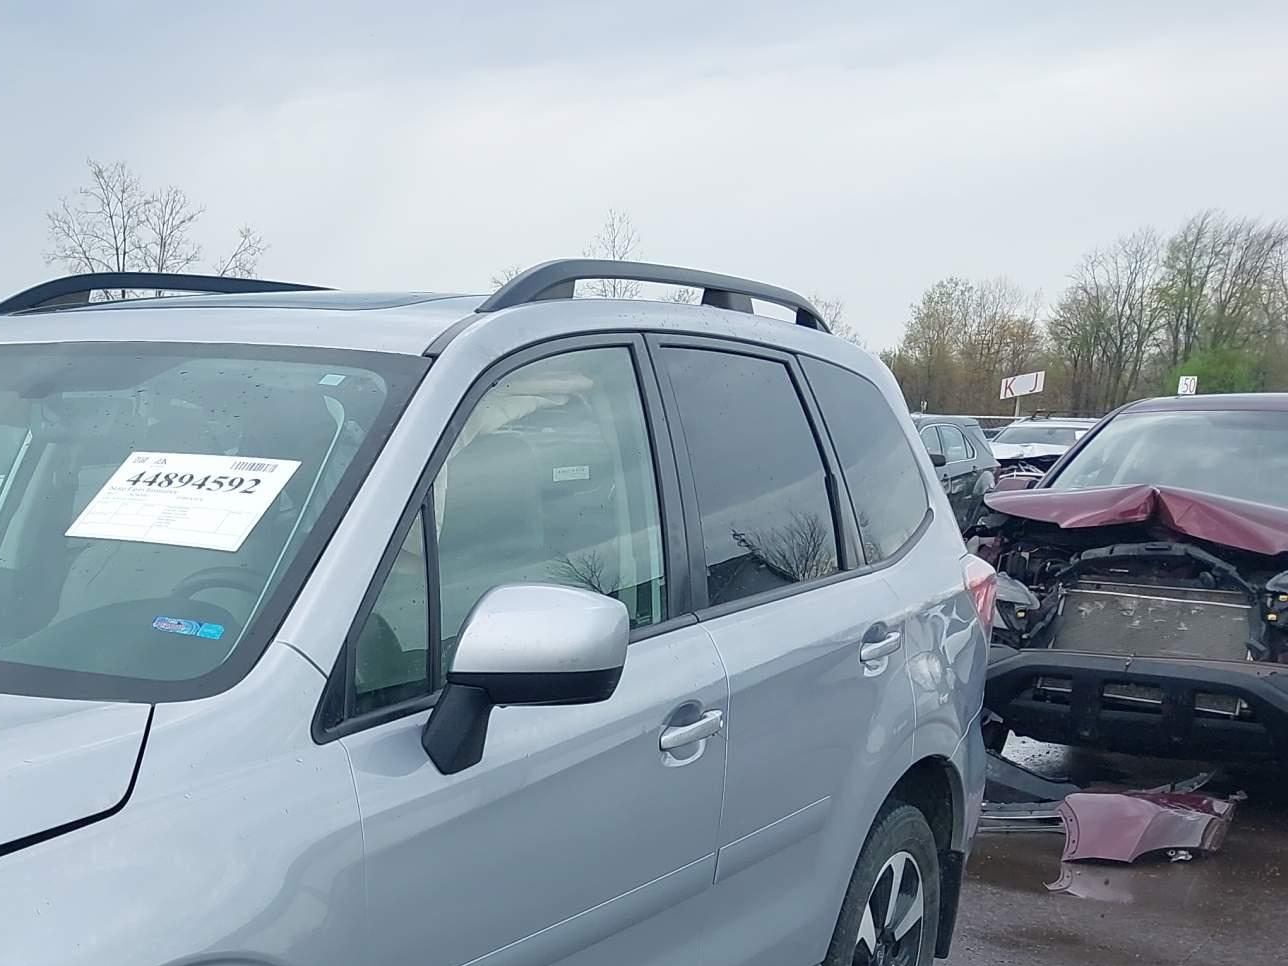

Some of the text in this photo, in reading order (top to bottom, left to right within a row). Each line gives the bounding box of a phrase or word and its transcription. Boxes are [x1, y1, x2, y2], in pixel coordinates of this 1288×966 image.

[1004, 373, 1039, 398] K J
[1181, 377, 1196, 394] 50
[126, 471, 262, 494] 44894592
